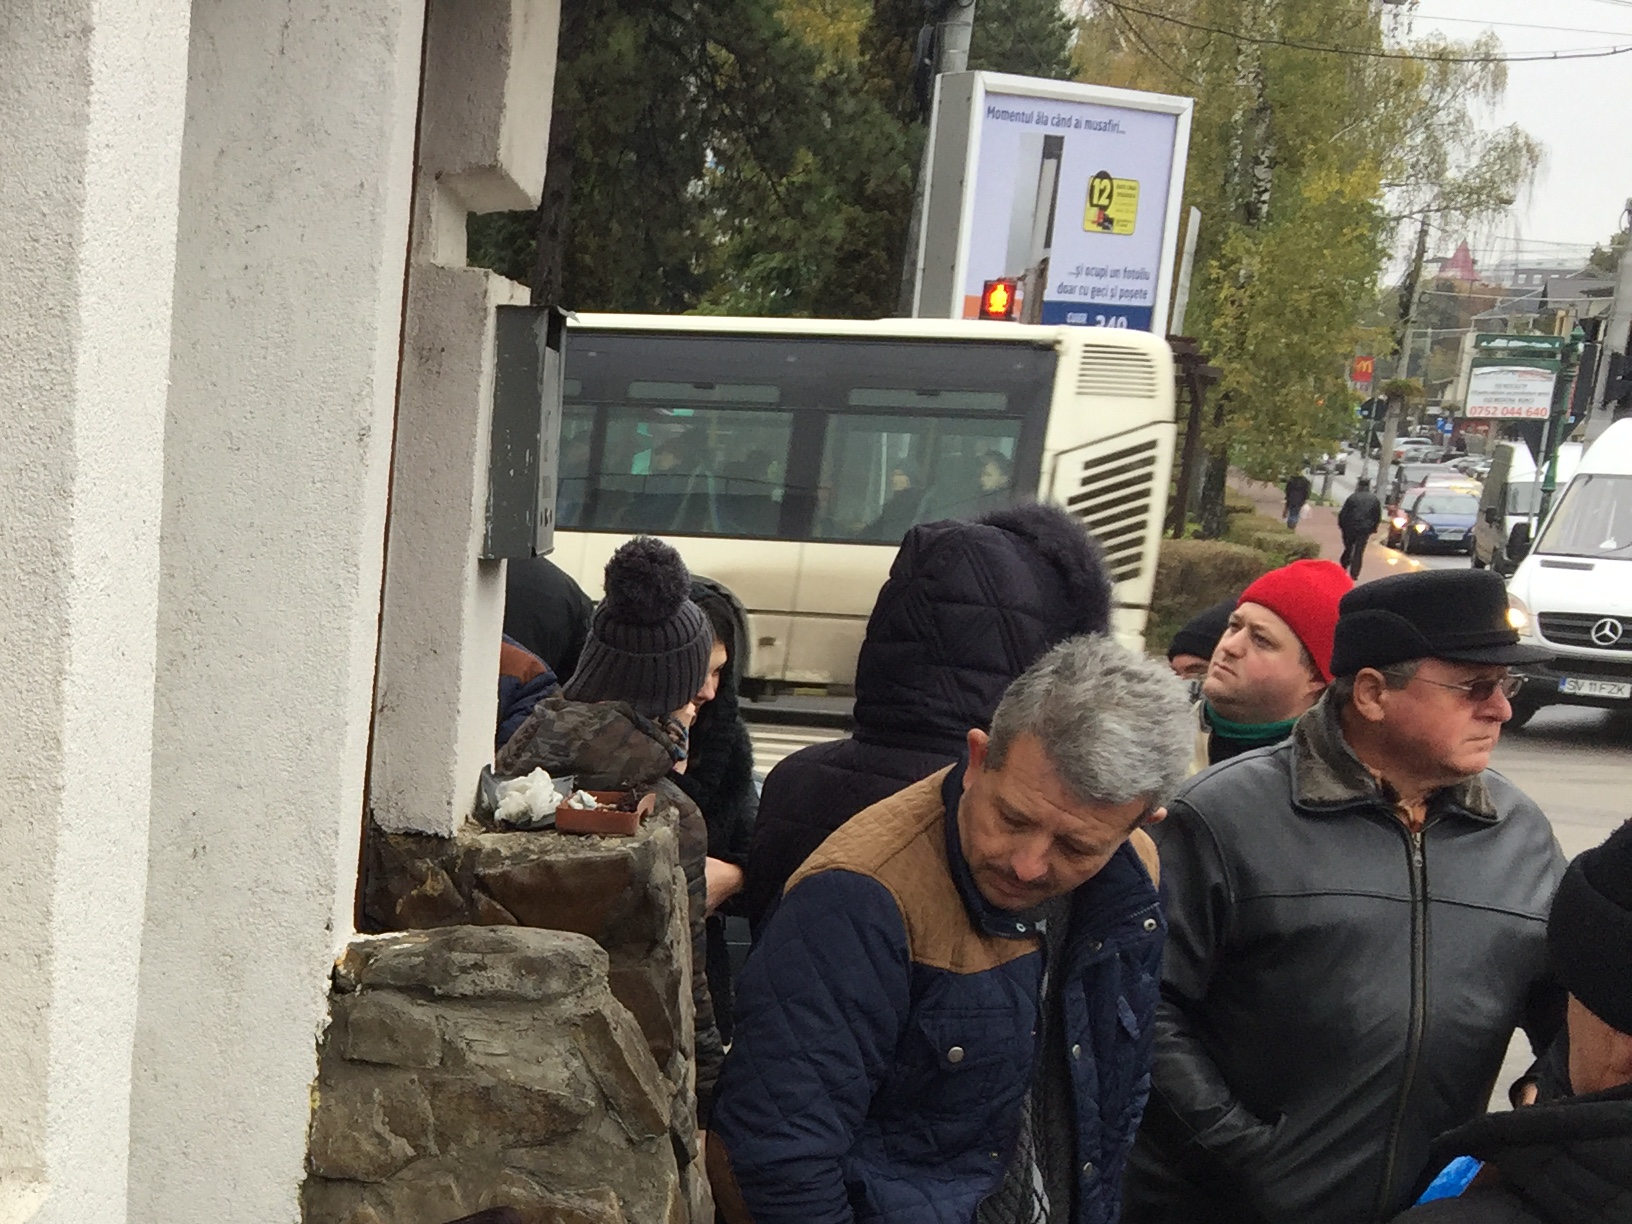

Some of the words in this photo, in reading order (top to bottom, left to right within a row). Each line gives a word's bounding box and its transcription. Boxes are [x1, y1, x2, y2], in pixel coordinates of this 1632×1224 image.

[986, 105, 1034, 124] Momentul
[1050, 113, 1073, 128] când
[1073, 116, 1082, 130] ai
[1092, 178, 1111, 206] 12
[1078, 285, 1089, 296] cu
[1470, 405, 1498, 416] 0752
[1501, 406, 1522, 417] 044
[1526, 407, 1548, 417] 640
[1567, 680, 1585, 691] SV
[1599, 682, 1626, 696] FZK
